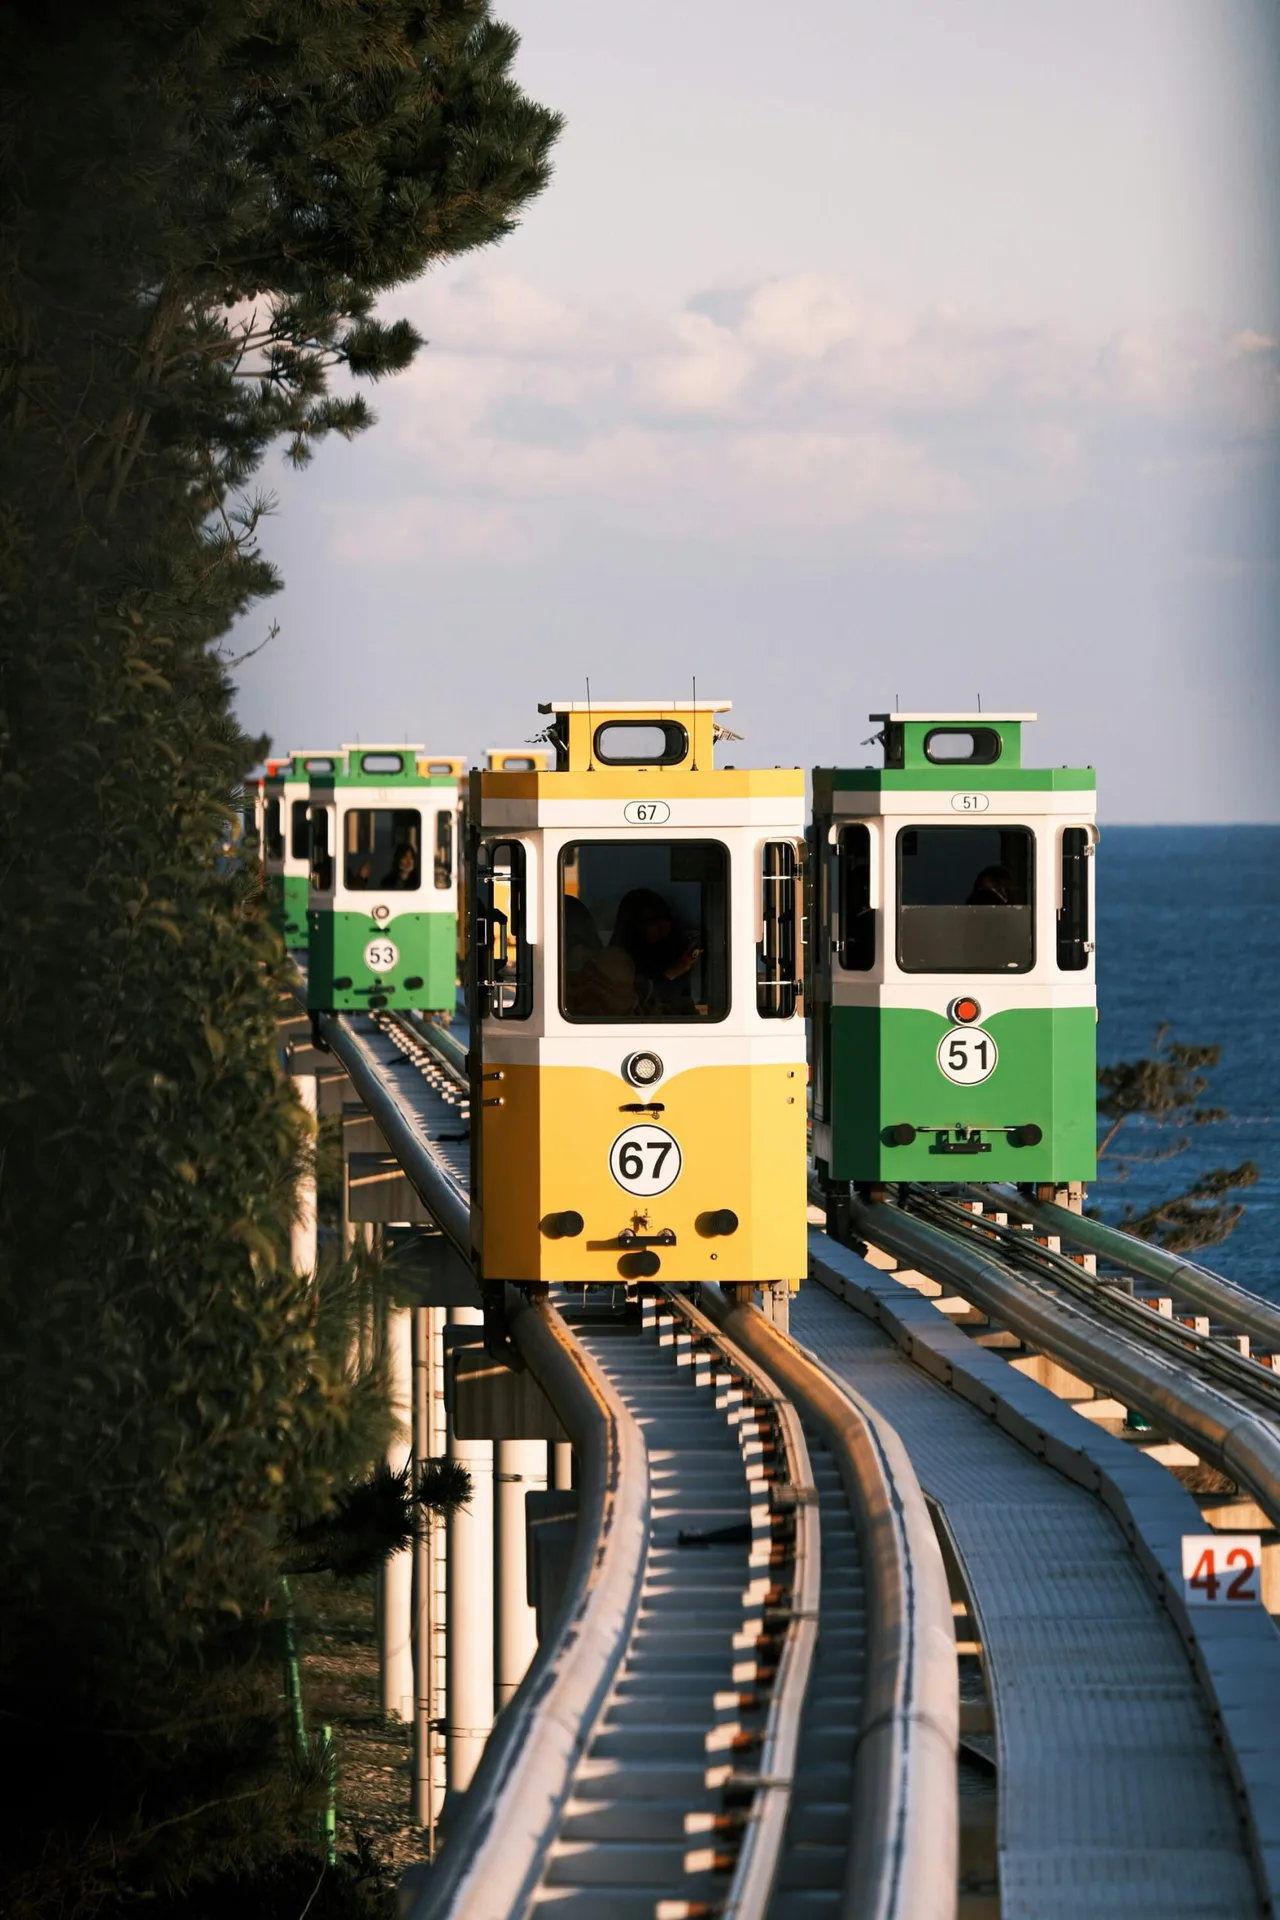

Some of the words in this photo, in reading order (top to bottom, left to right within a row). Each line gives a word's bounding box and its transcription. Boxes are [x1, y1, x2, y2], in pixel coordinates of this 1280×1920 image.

[637, 804, 657, 821] 67
[963, 796, 977, 809] 51
[369, 946, 394, 965] 53
[948, 1040, 988, 1071] 51
[618, 1141, 673, 1180] 67
[1189, 1548, 1256, 1601] 42
